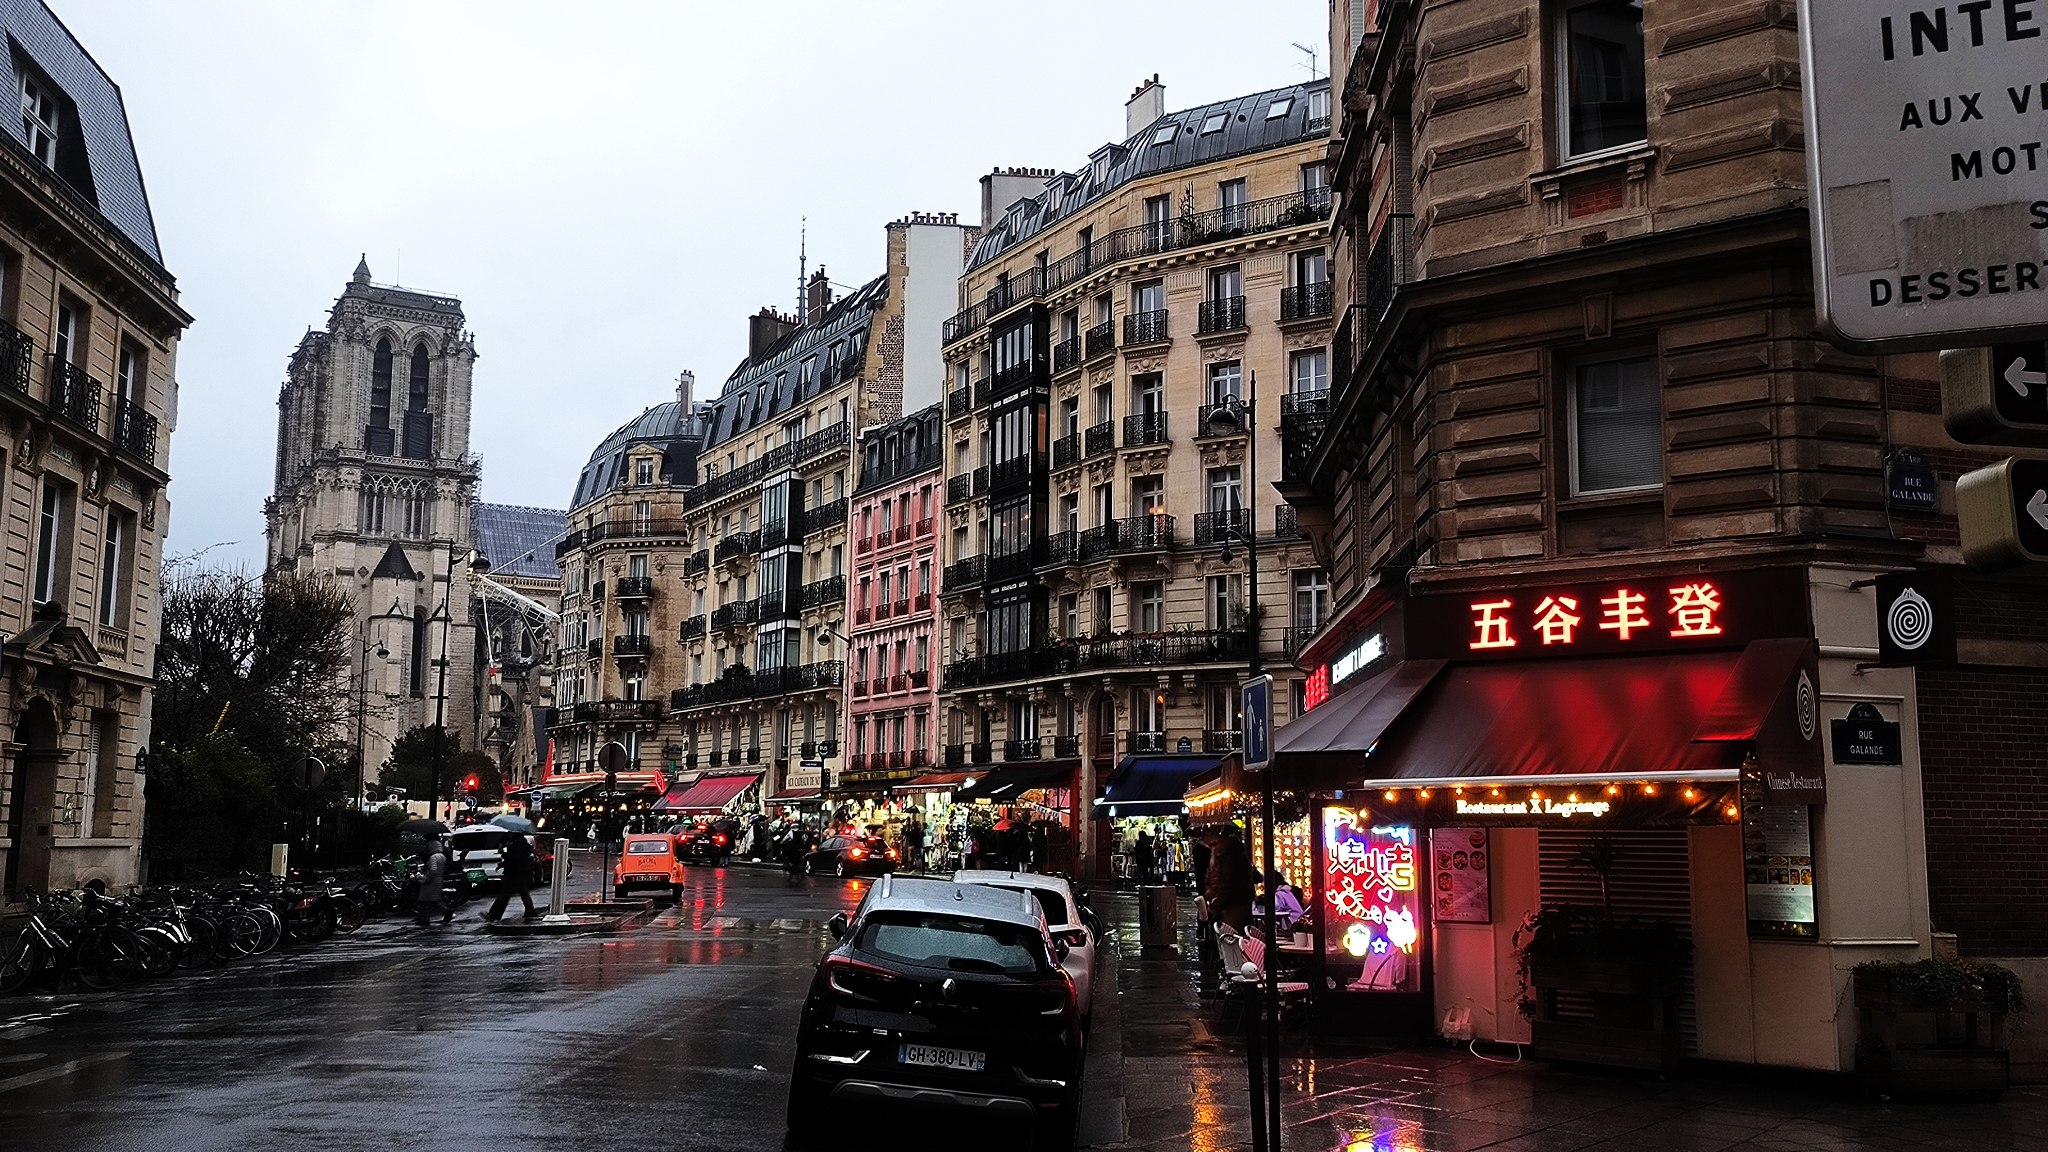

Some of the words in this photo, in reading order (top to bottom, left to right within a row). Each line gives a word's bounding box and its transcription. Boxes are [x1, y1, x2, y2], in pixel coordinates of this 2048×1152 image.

[1881, 0, 2041, 61] INTE
[1899, 92, 1984, 131] AUX
[1951, 142, 2048, 182] MOT
[1869, 260, 2048, 307] DESSER
[1904, 477, 1922, 487] RUE
[1892, 489, 1935, 502] GALANDE
[1469, 582, 1723, 651] 五谷丰登
[1858, 730, 1874, 740] RUE
[1850, 745, 1884, 755] GALANDE
[1790, 771, 1823, 790] Restaurant
[1456, 799, 1528, 814] Restaurant
[1529, 799, 1543, 814] X
[1544, 799, 1610, 818] Lagrange
